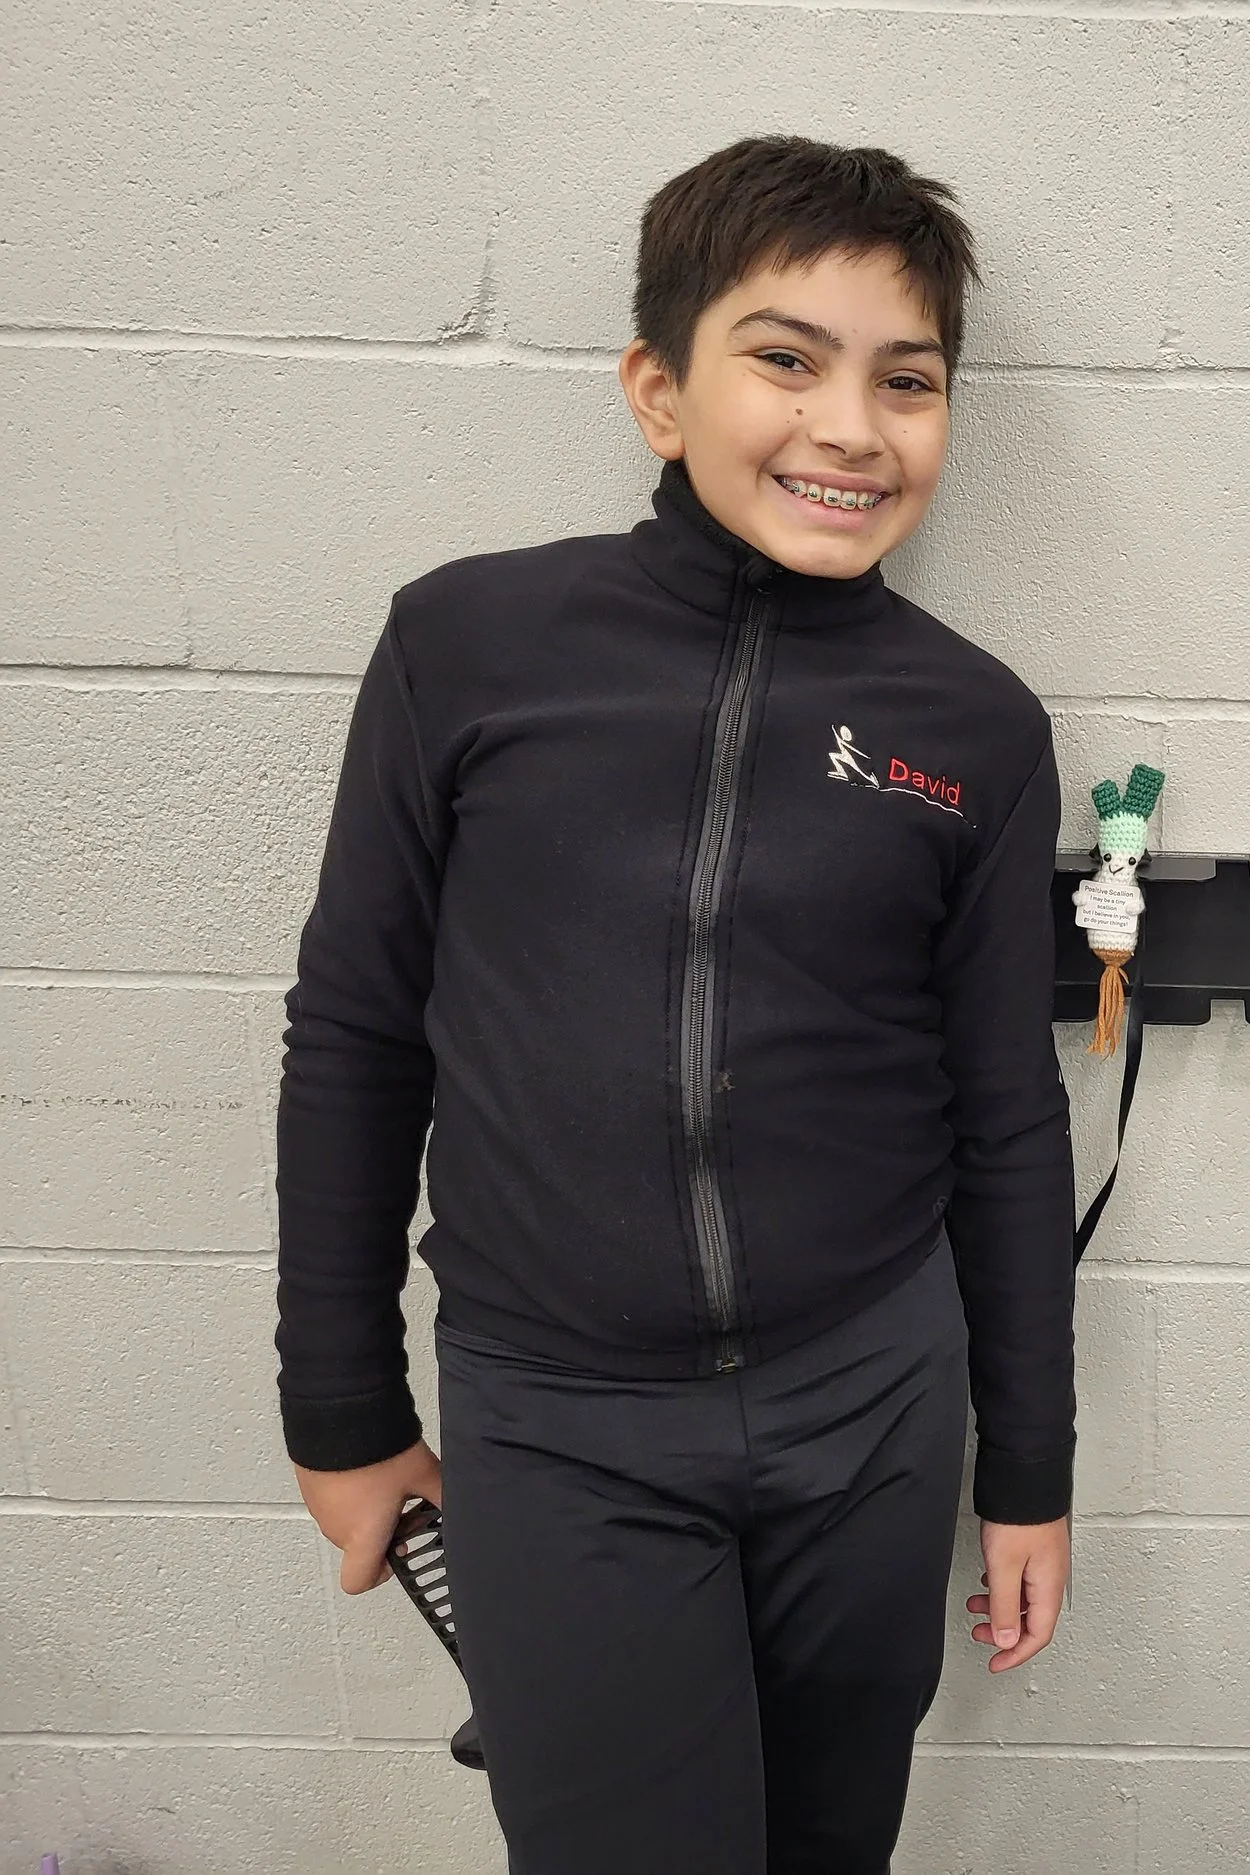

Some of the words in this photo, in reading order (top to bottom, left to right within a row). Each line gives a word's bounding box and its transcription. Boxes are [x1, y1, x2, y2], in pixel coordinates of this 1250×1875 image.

[888, 757, 961, 806] David
[1084, 885, 1108, 894] Positive
[1109, 889, 1134, 898] Scallion
